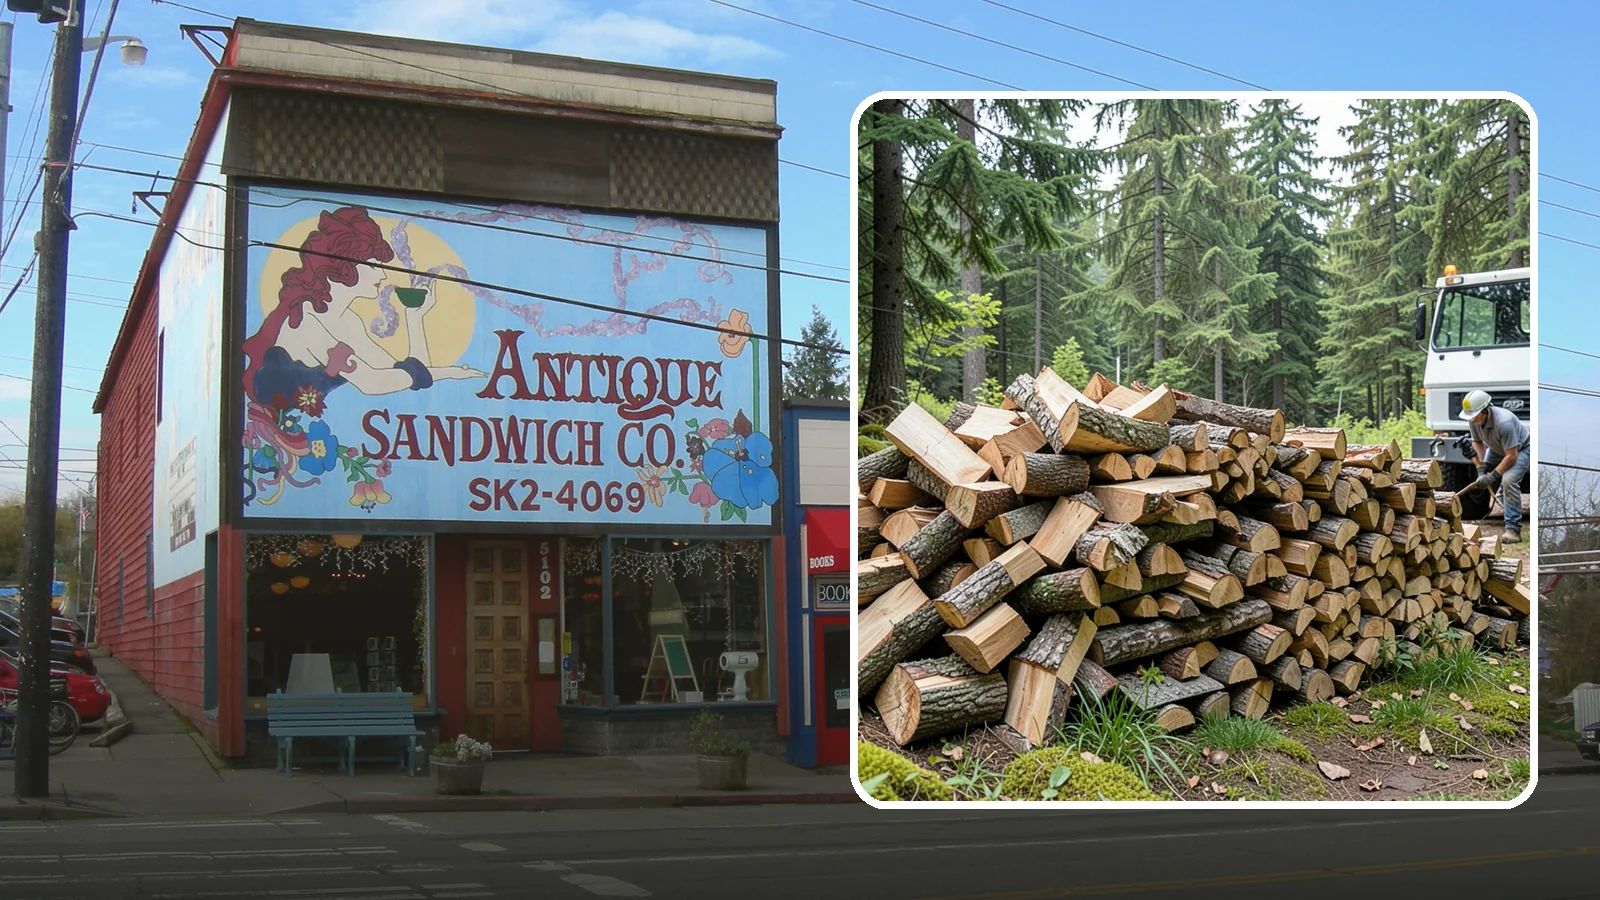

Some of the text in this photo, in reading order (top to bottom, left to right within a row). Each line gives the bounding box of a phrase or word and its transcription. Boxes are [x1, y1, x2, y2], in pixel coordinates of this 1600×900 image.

[477, 329, 722, 420] ANTIQUE
[361, 409, 685, 469] SANDWICH CO.
[468, 477, 646, 513] SK2-4069
[540, 542, 552, 599] 5102
[810, 555, 835, 569] BOOKS
